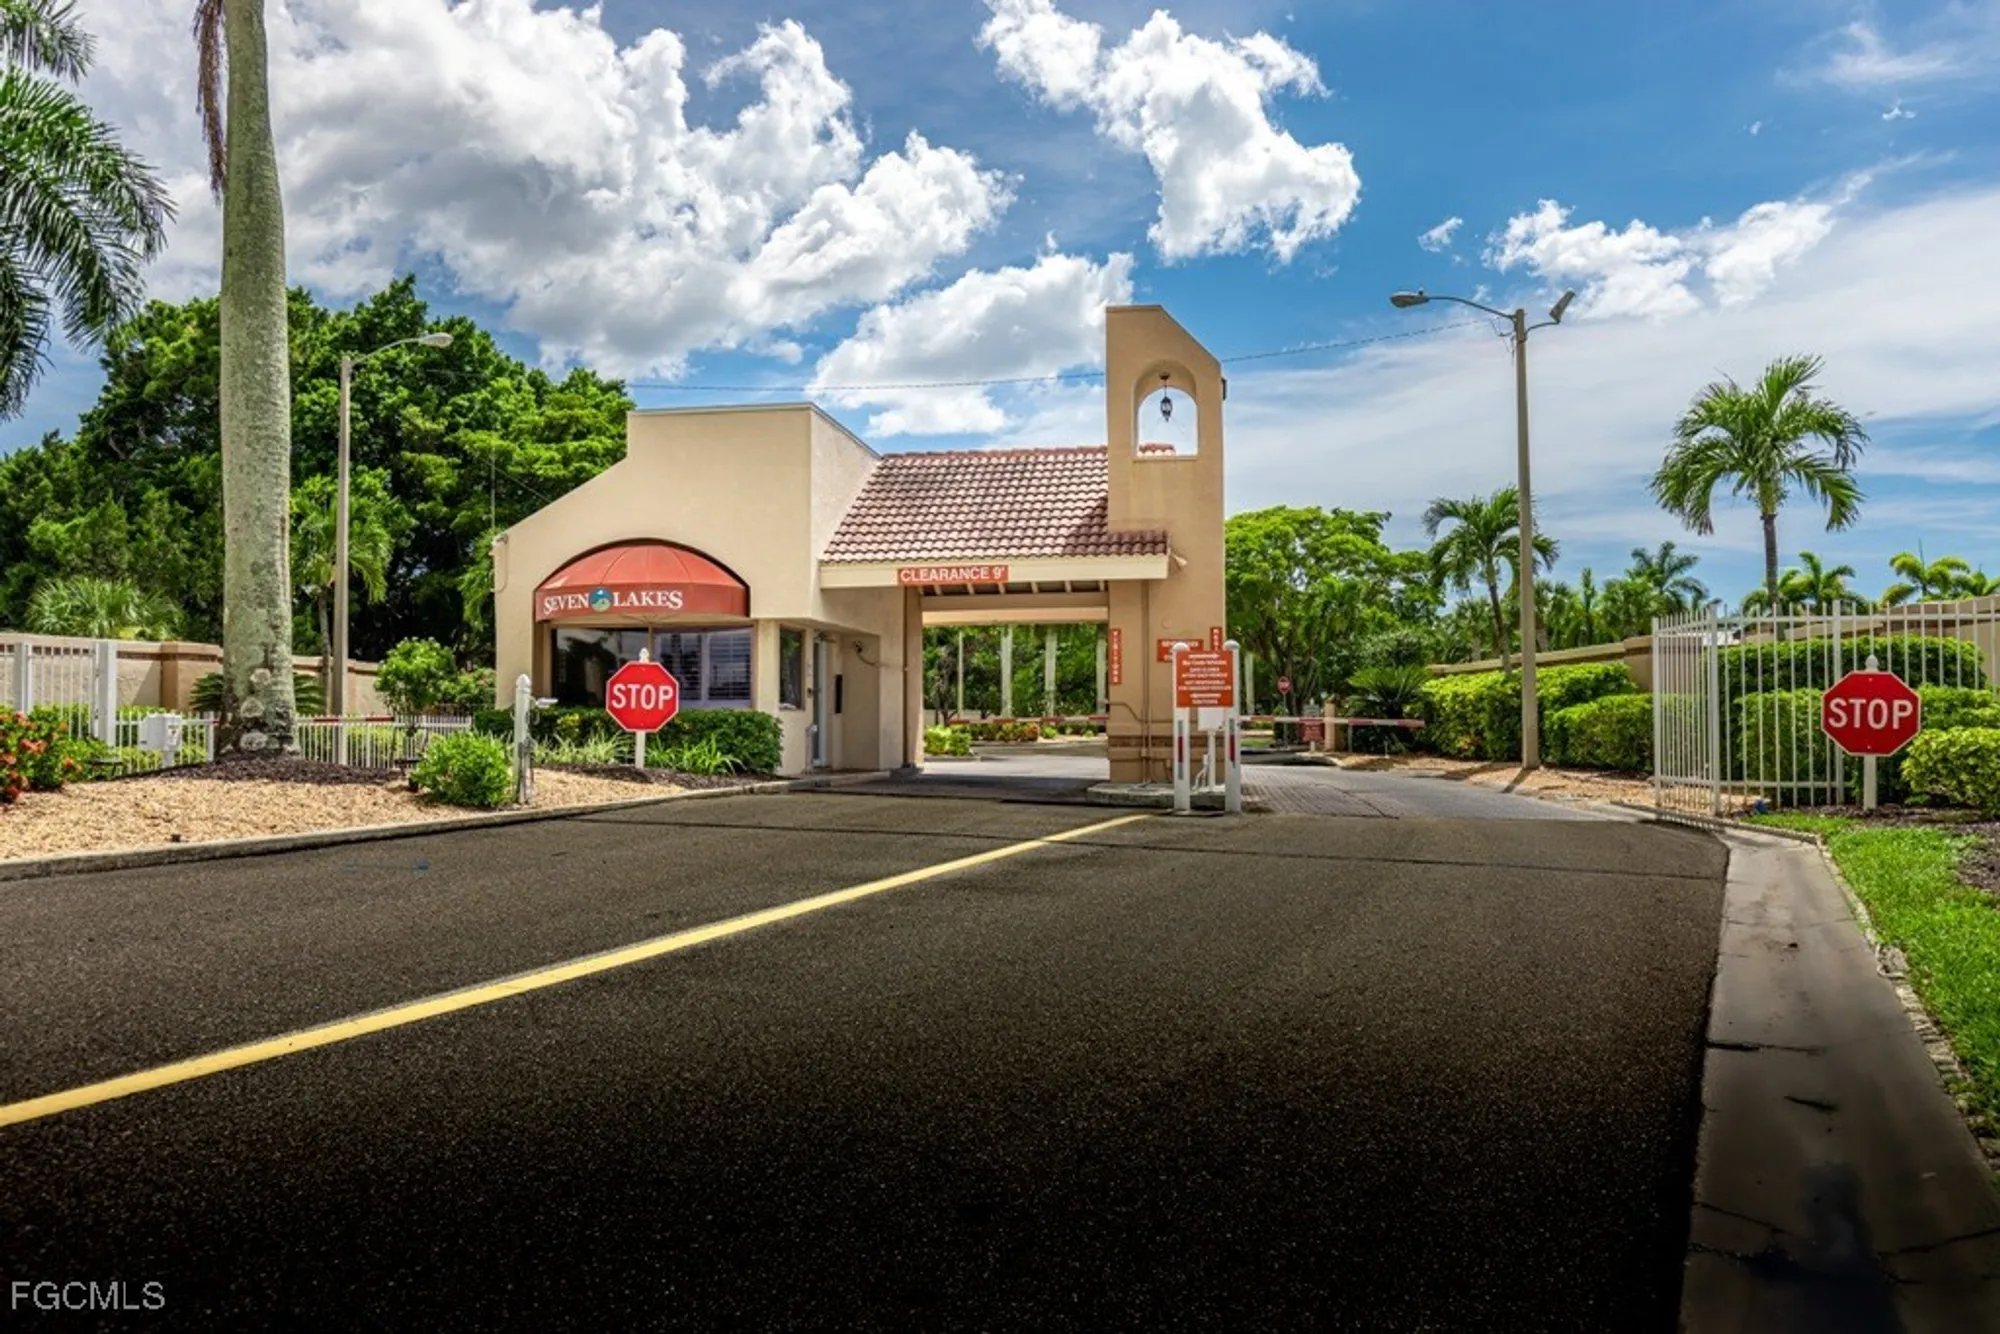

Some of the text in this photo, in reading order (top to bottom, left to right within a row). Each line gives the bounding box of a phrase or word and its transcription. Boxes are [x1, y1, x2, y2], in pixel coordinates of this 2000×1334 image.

[900, 567, 990, 582] CLEARANCE
[543, 590, 683, 615] SEVEN LAKES
[611, 683, 674, 710] STOP
[1828, 697, 1914, 730] STOP
